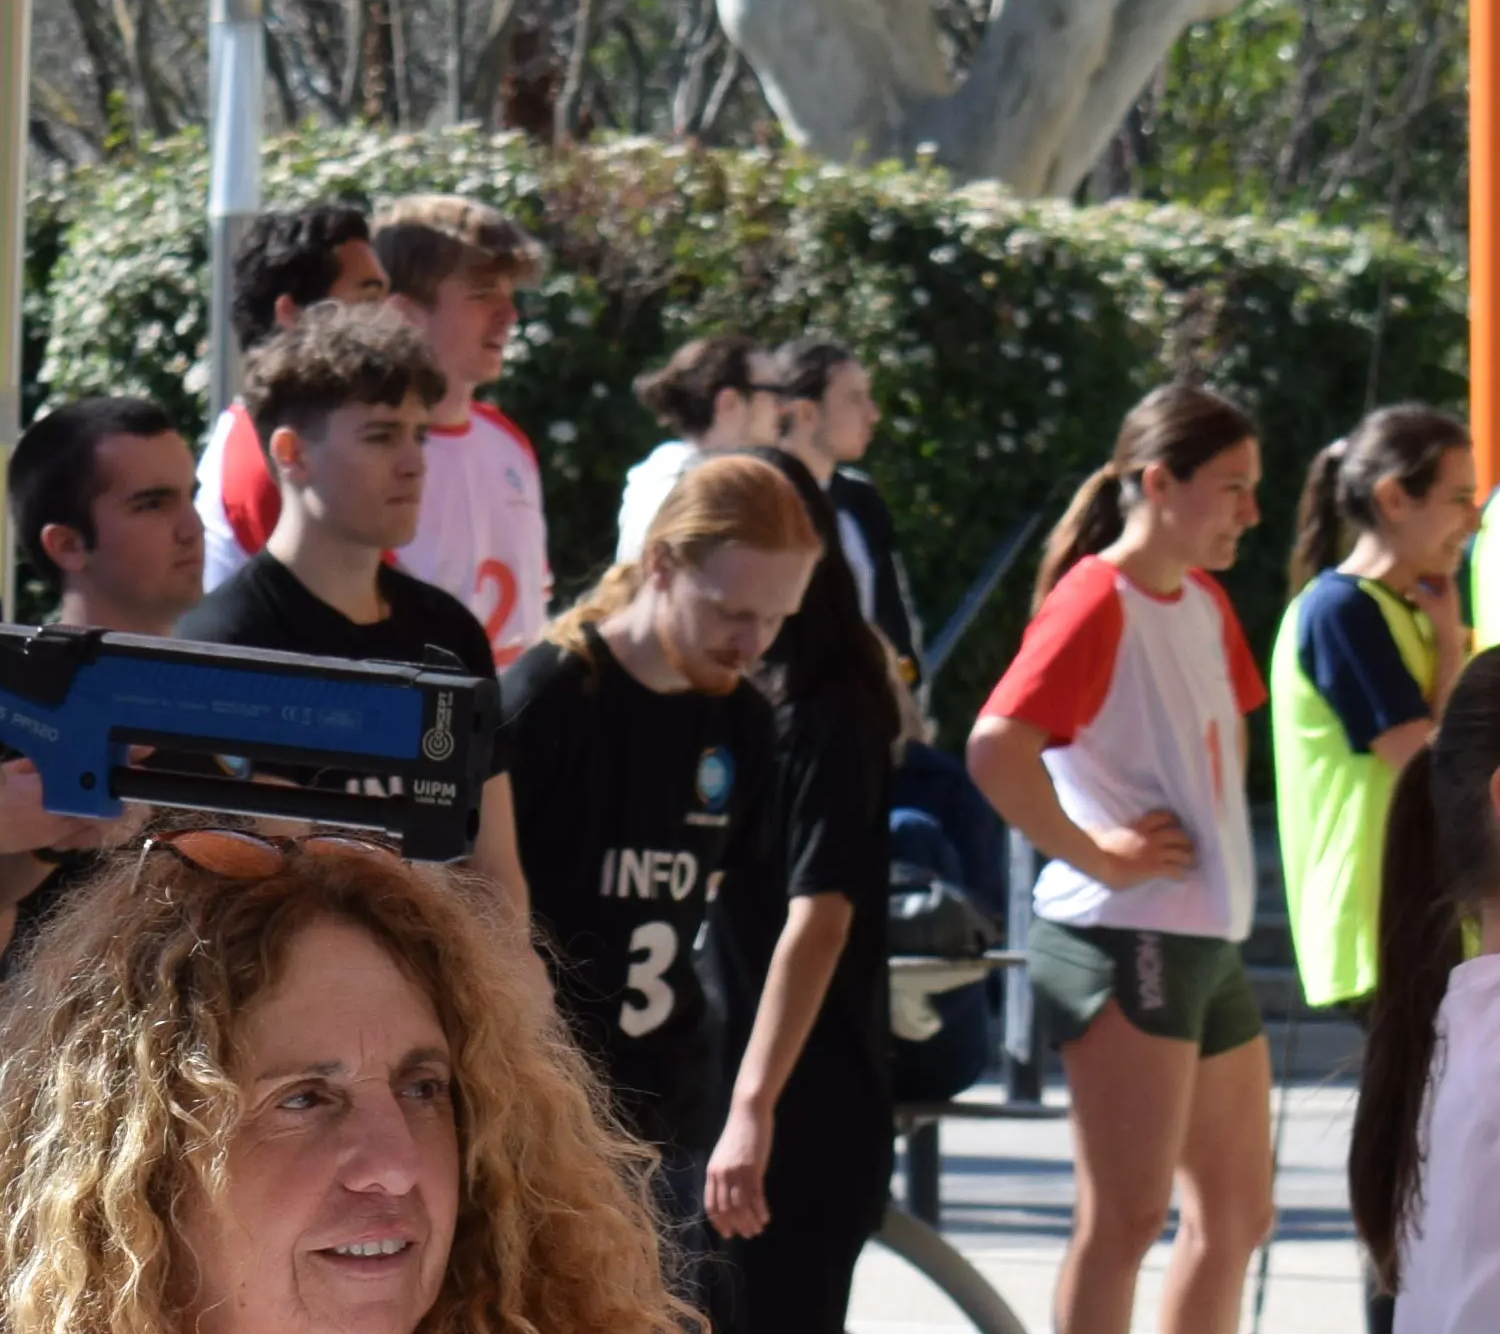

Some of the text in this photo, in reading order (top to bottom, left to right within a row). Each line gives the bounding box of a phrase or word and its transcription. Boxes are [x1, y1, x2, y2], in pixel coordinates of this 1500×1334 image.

[474, 557, 525, 668] 2
[413, 778, 457, 799] UIPM
[599, 846, 698, 902] INFO
[618, 920, 680, 1038] 3
